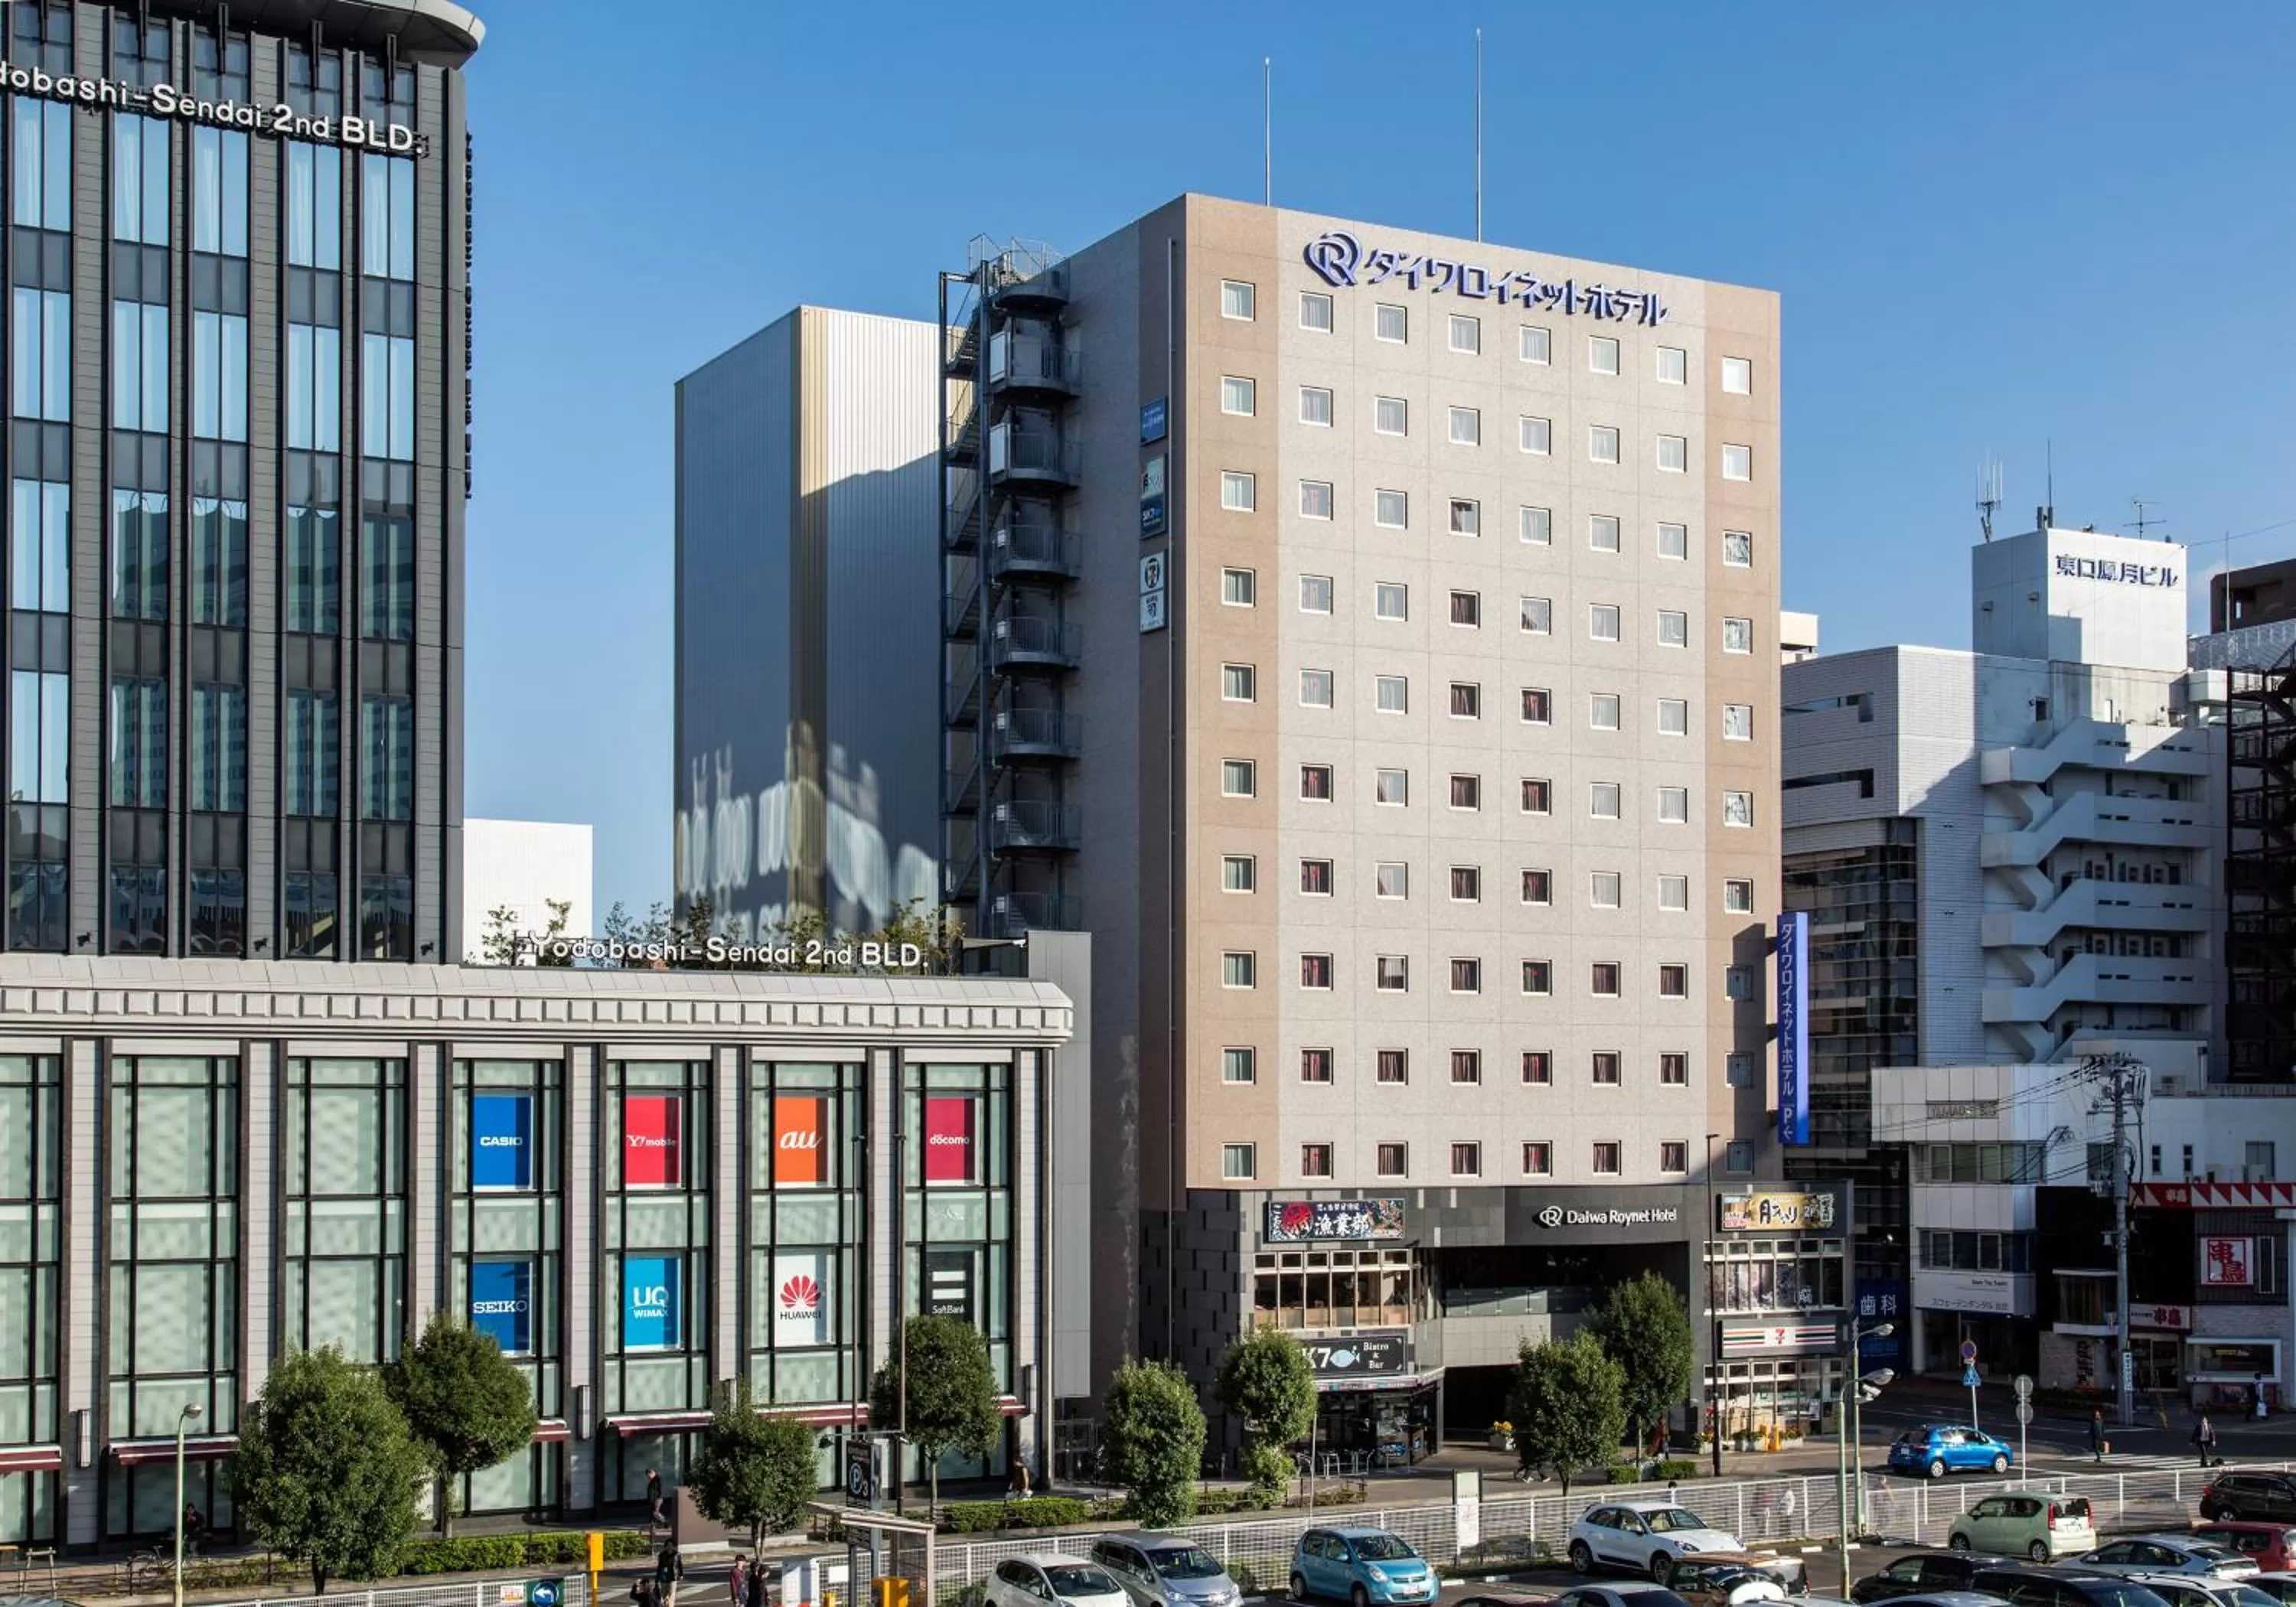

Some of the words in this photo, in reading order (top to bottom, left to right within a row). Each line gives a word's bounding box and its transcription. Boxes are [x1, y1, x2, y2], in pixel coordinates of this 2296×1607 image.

[273, 104, 329, 139] 2nd
[342, 116, 423, 154] BLD.
[1365, 247, 1669, 327] ダイワロイネットホテル
[805, 940, 852, 965] 2nd
[860, 942, 929, 968] BLD.
[1780, 923, 1796, 1097] ダイワロイネットホテル
[1784, 1108, 1792, 1123] P
[480, 1136, 523, 1146] CASIO
[780, 1130, 822, 1149] au
[930, 1134, 970, 1145] docomo
[1567, 1210, 1607, 1224] Daiwa
[1609, 1208, 1650, 1227] Roynet
[1652, 1207, 1678, 1222] Hotel
[633, 1286, 669, 1307] UQ
[1861, 1293, 1897, 1316] 歯科
[474, 1300, 527, 1314] SEIKO
[780, 1311, 821, 1320] HUAWEI
[931, 1305, 965, 1315] SoftBank
[1363, 1341, 1389, 1351] Bistro
[1368, 1360, 1384, 1369] Bar
